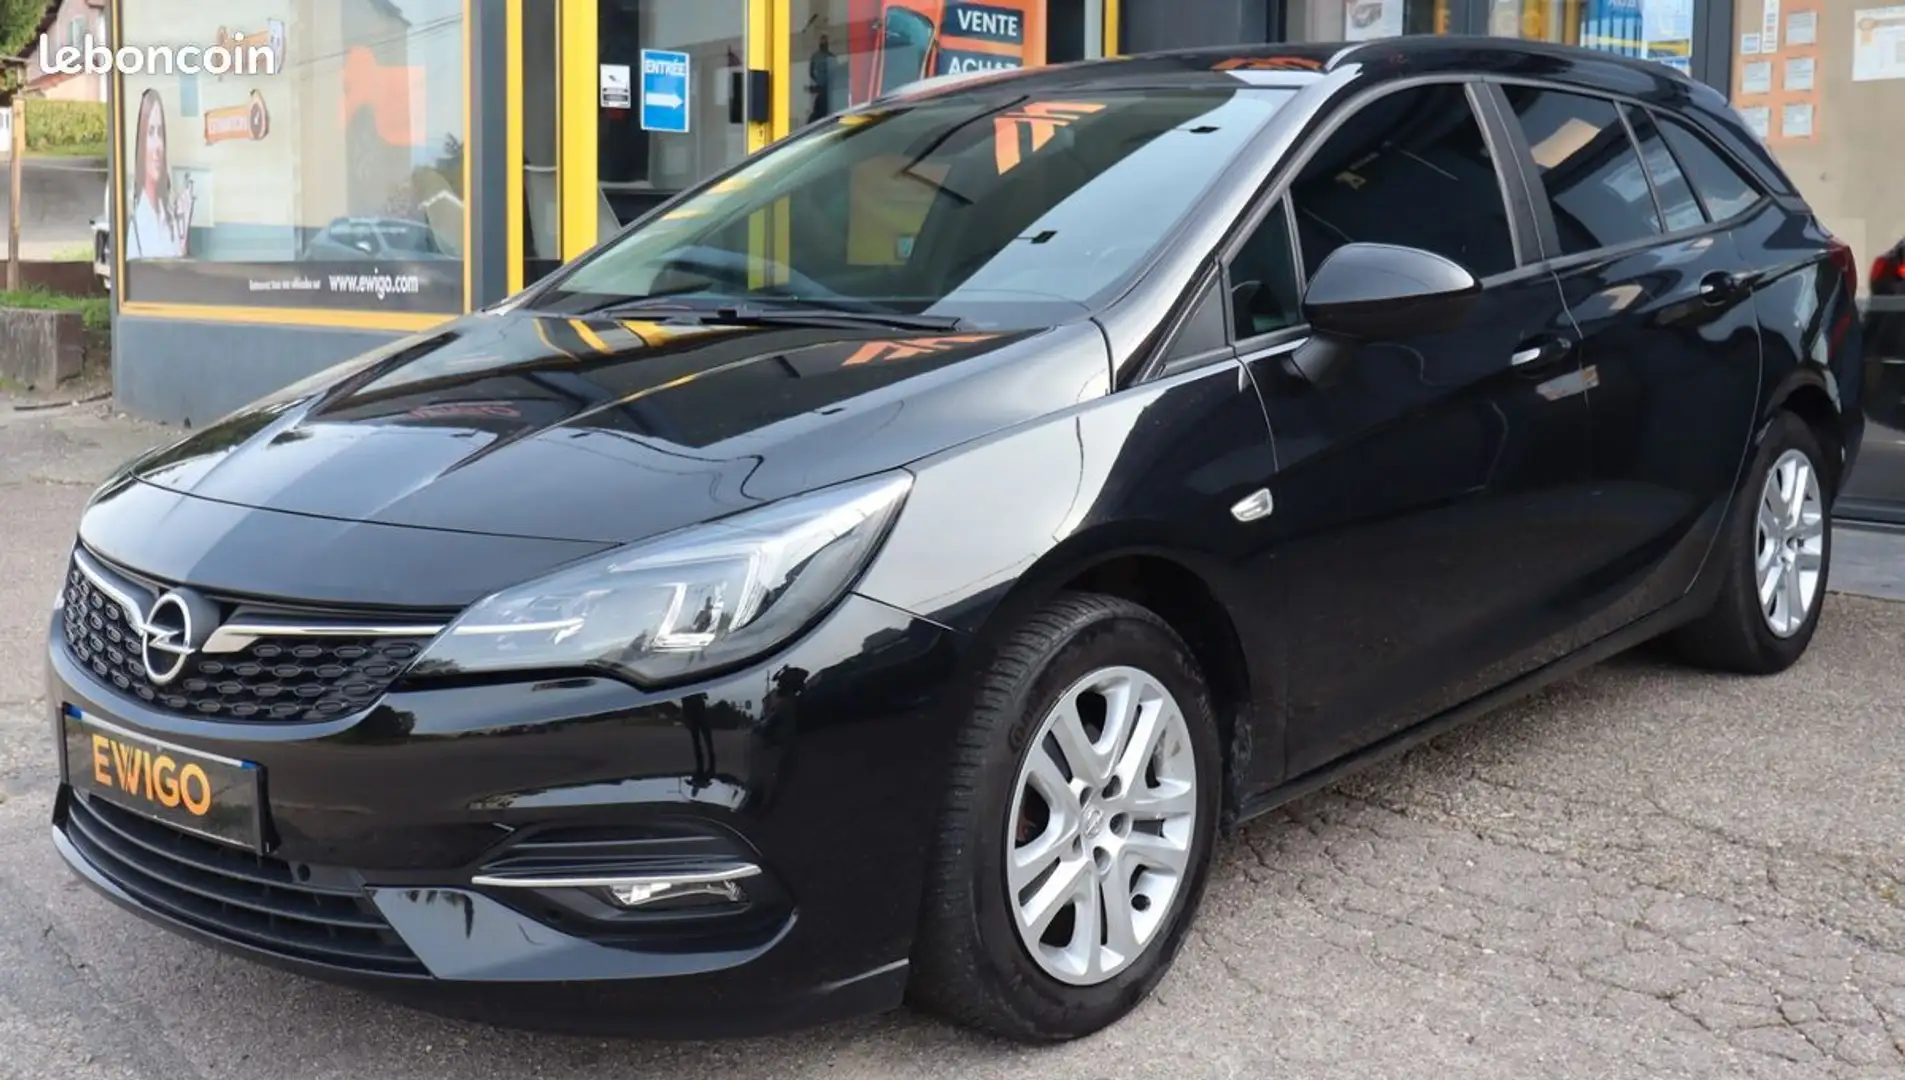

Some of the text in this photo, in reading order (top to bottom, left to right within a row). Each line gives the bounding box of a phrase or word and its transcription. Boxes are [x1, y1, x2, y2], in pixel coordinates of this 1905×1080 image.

[957, 8, 1018, 37] VENTE
[643, 57, 686, 77] ENTRÉE
[328, 267, 419, 300] www.ewigo.com
[92, 733, 211, 816] EWIGO
